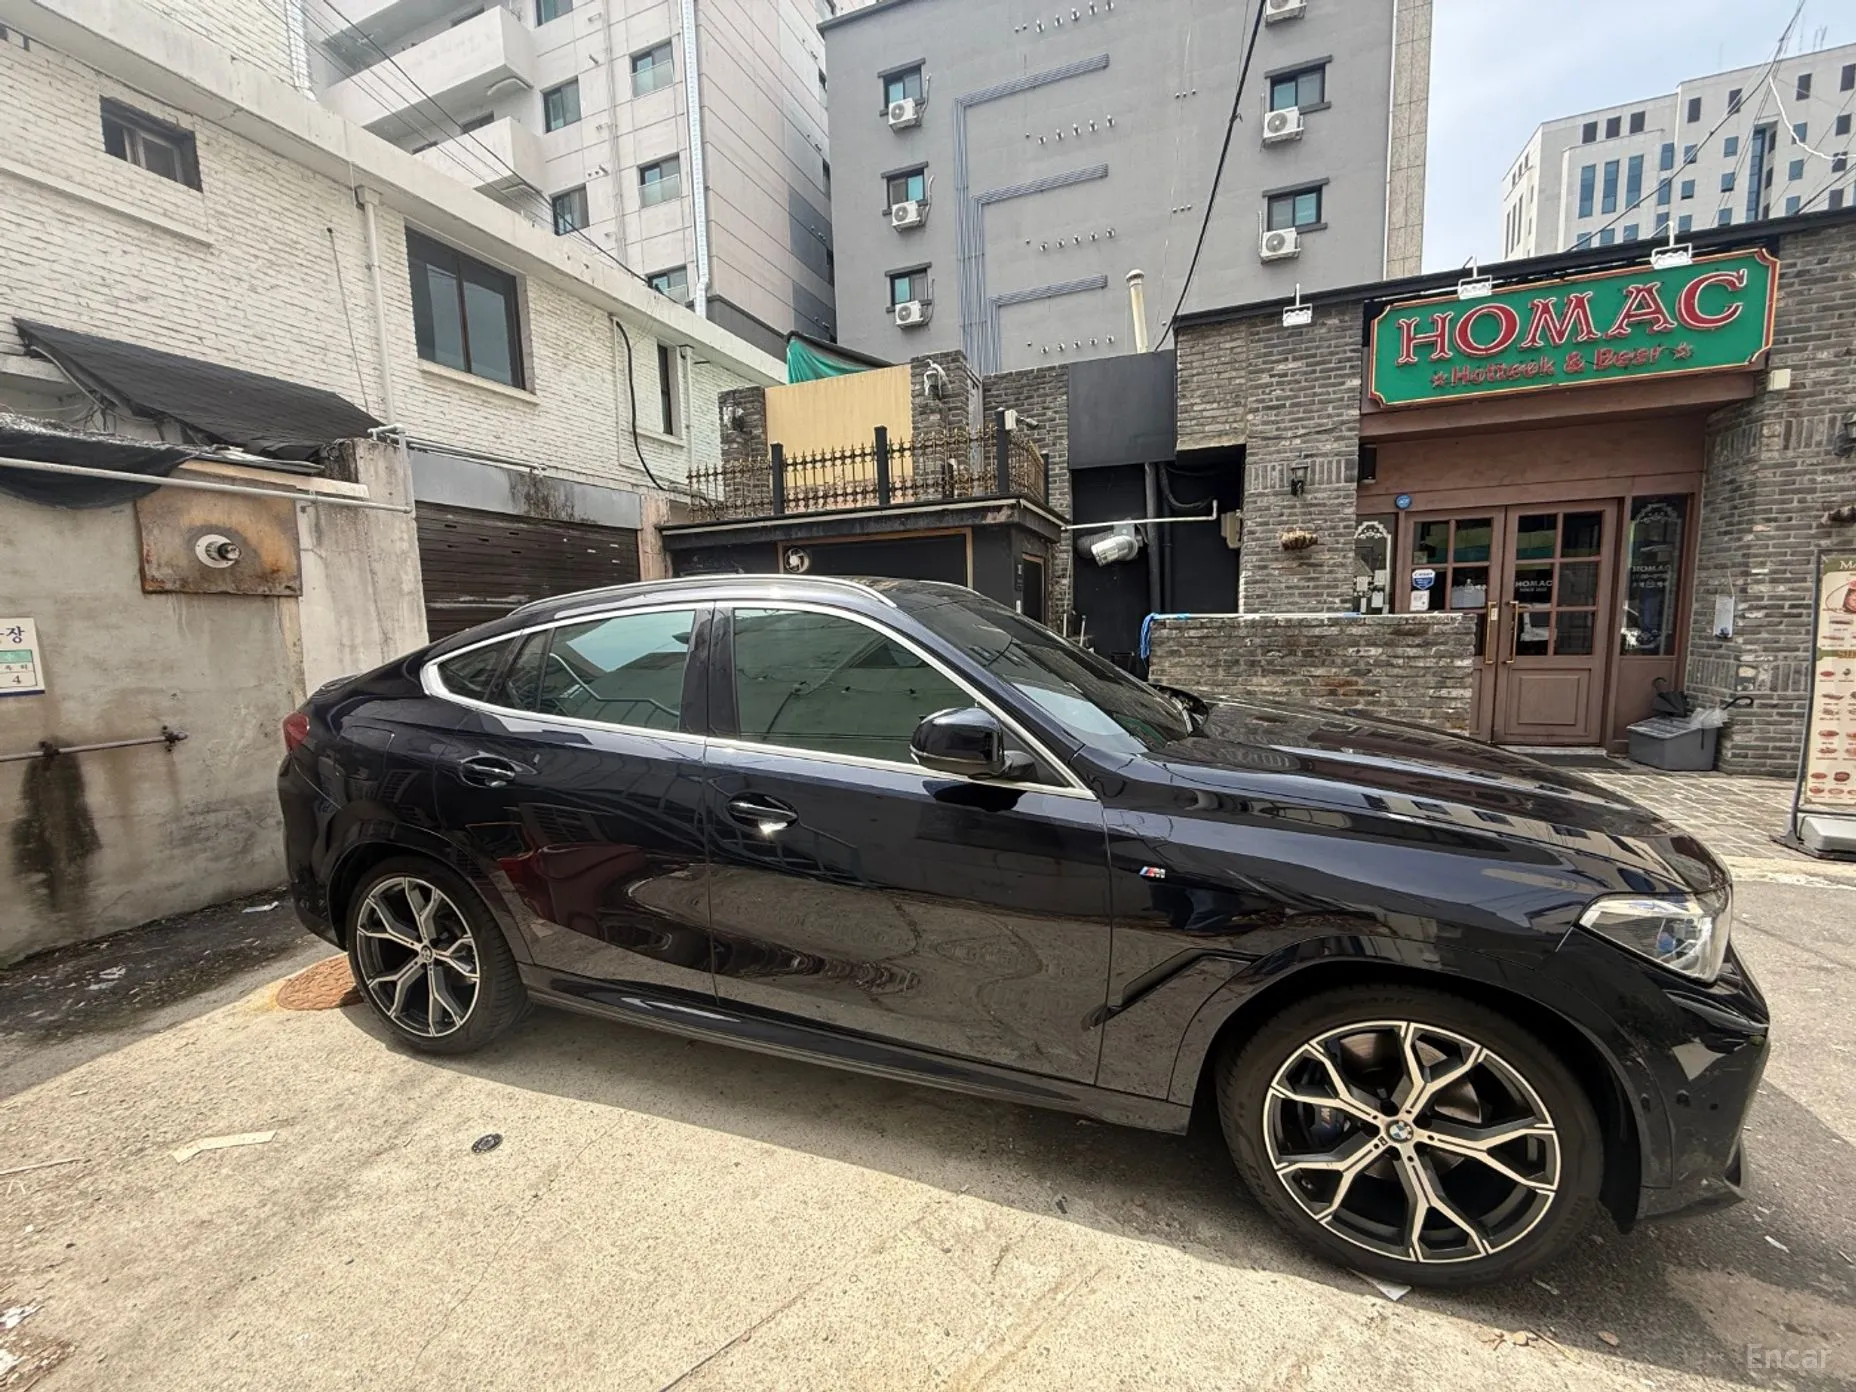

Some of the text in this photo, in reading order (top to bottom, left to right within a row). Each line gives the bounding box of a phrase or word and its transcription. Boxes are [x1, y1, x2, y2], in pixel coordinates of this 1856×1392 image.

[1397, 267, 1748, 365] HOMAC
[1563, 351, 1585, 374] &
[1594, 344, 1665, 372] Beer
[1515, 580, 1553, 588] HOMAC
[0, 625, 25, 644] 장
